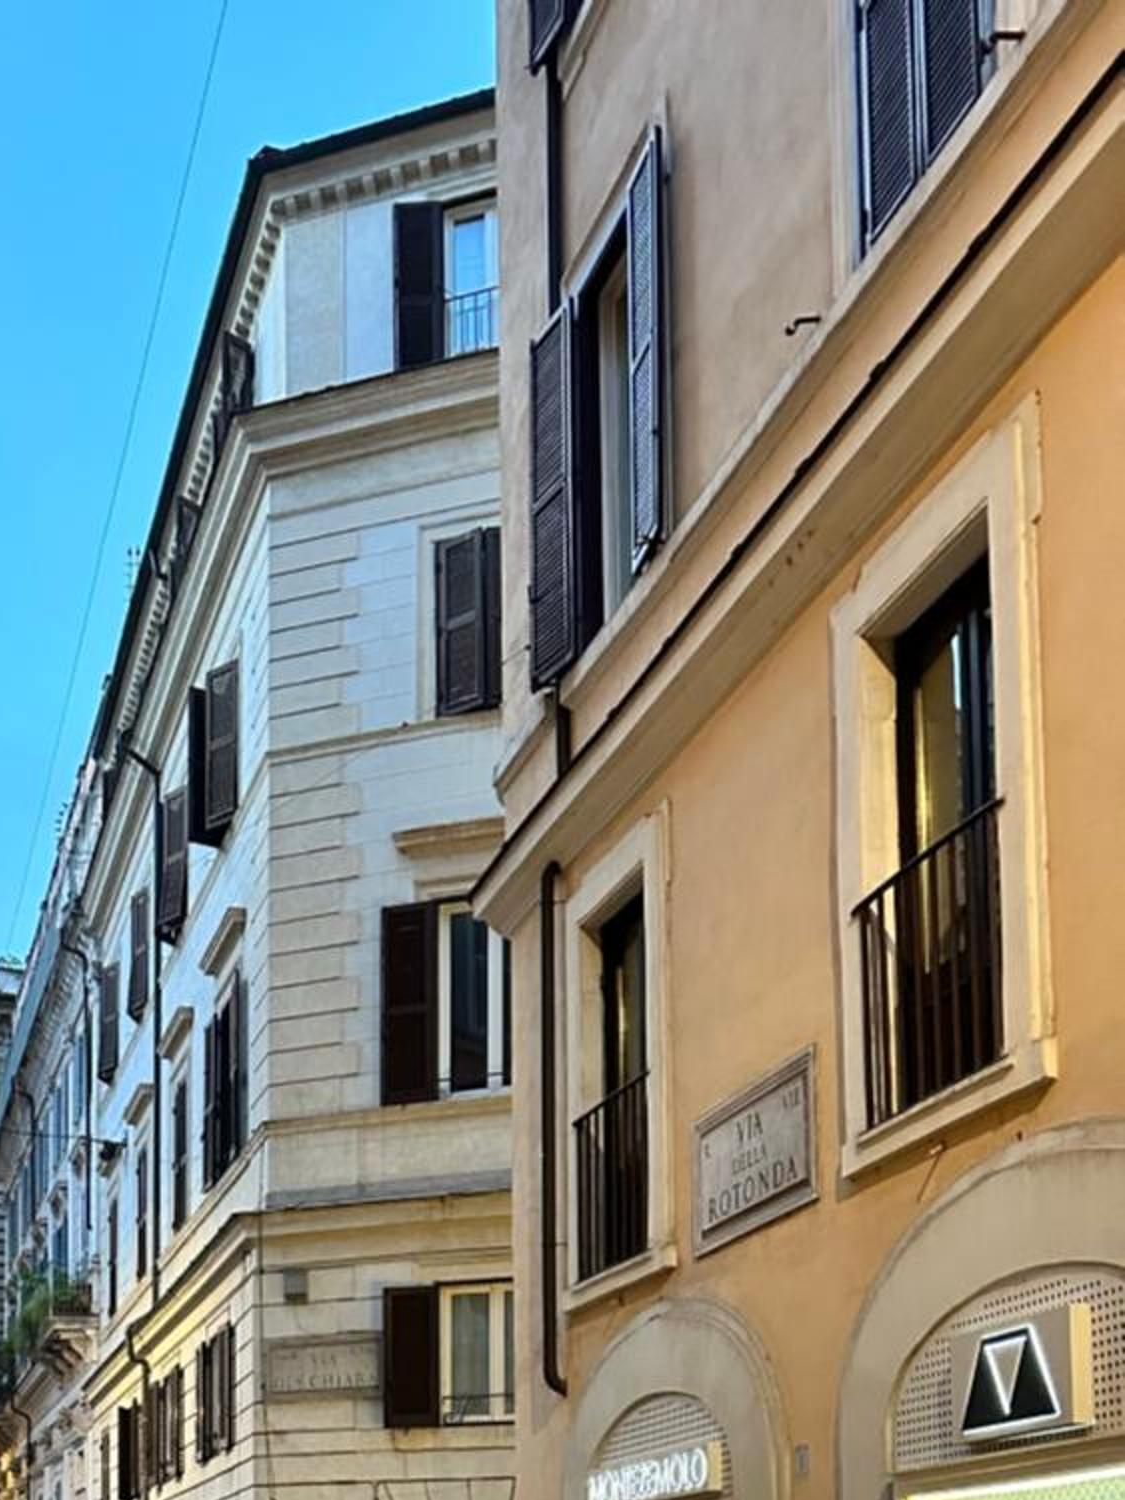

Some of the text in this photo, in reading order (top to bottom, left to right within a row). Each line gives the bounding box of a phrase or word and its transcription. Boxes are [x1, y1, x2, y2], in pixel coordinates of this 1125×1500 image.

[736, 1110, 765, 1146] VIA
[732, 1144, 768, 1176] DELLA
[707, 1156, 798, 1223] ROTONDA
